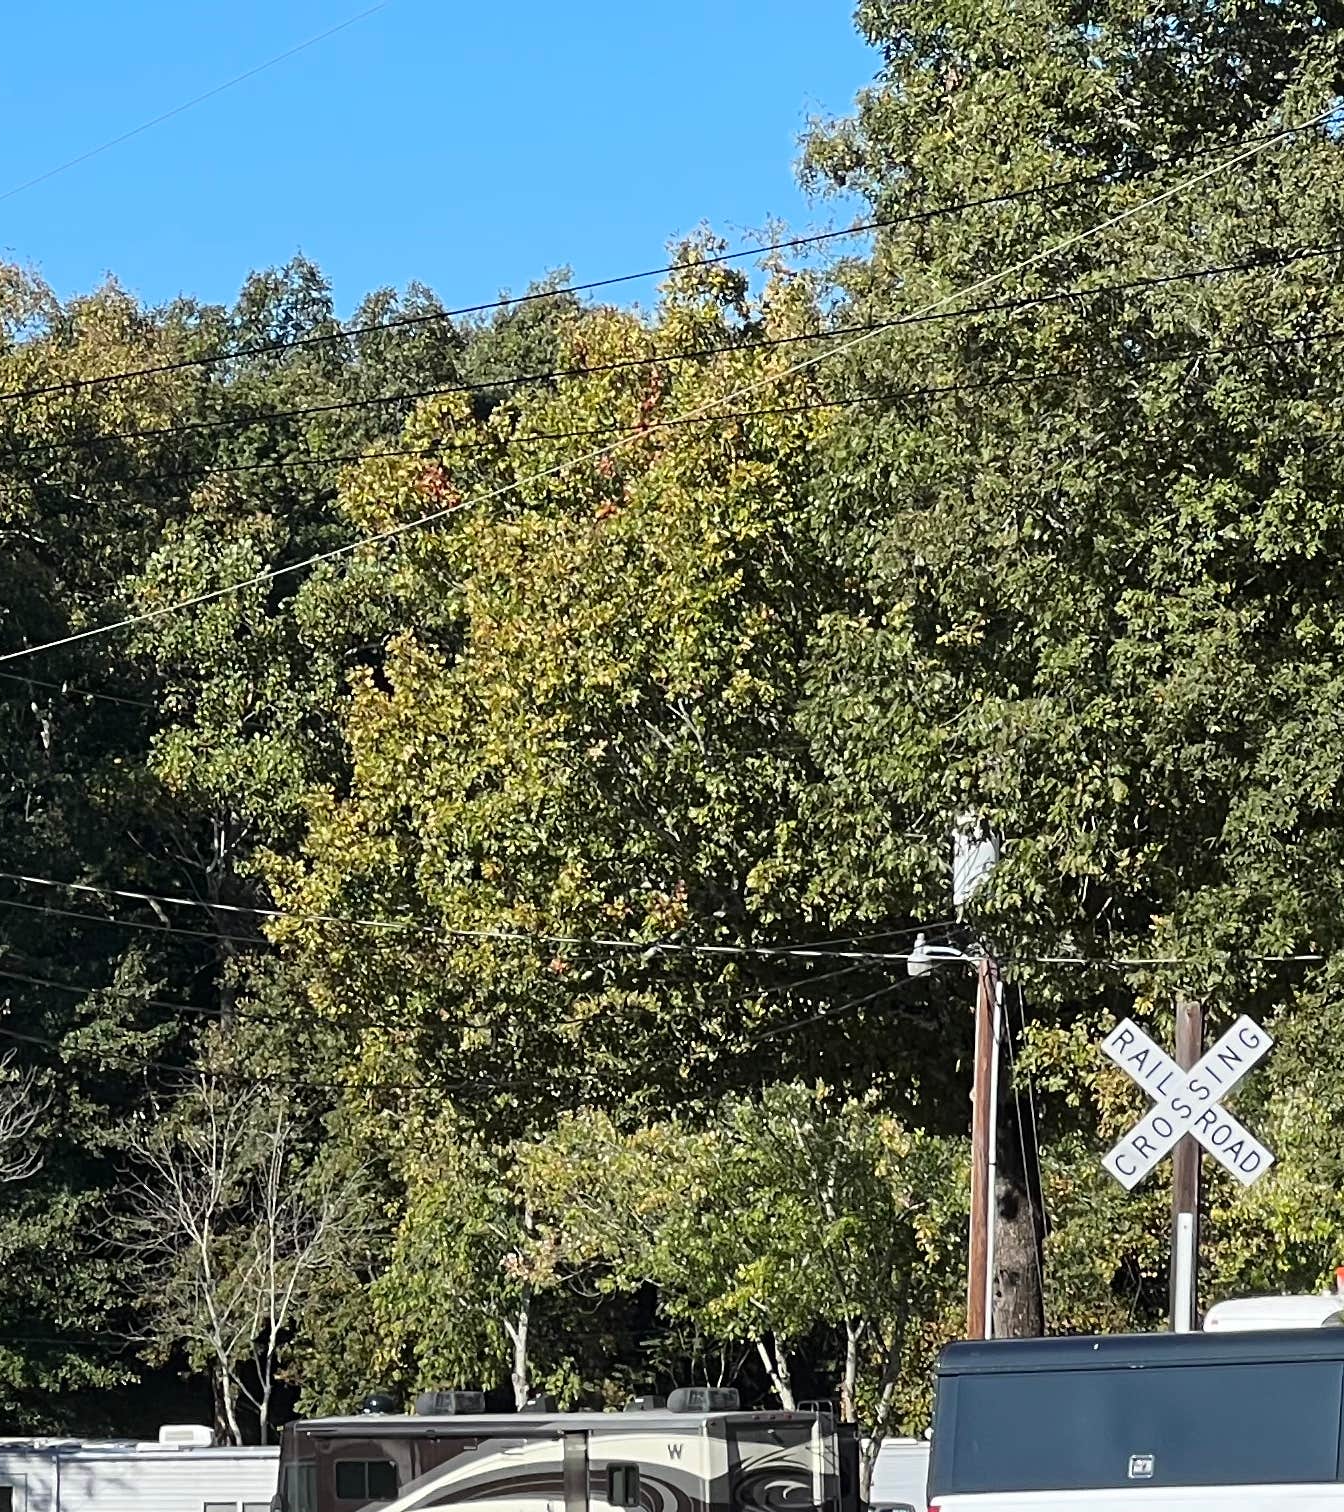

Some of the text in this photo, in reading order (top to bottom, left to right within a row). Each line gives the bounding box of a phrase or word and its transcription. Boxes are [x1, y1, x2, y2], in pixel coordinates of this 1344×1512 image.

[1111, 1028, 1261, 1174] RAILROAD
[1114, 1026, 1260, 1176] CROSSING
[667, 1443, 684, 1460] W
